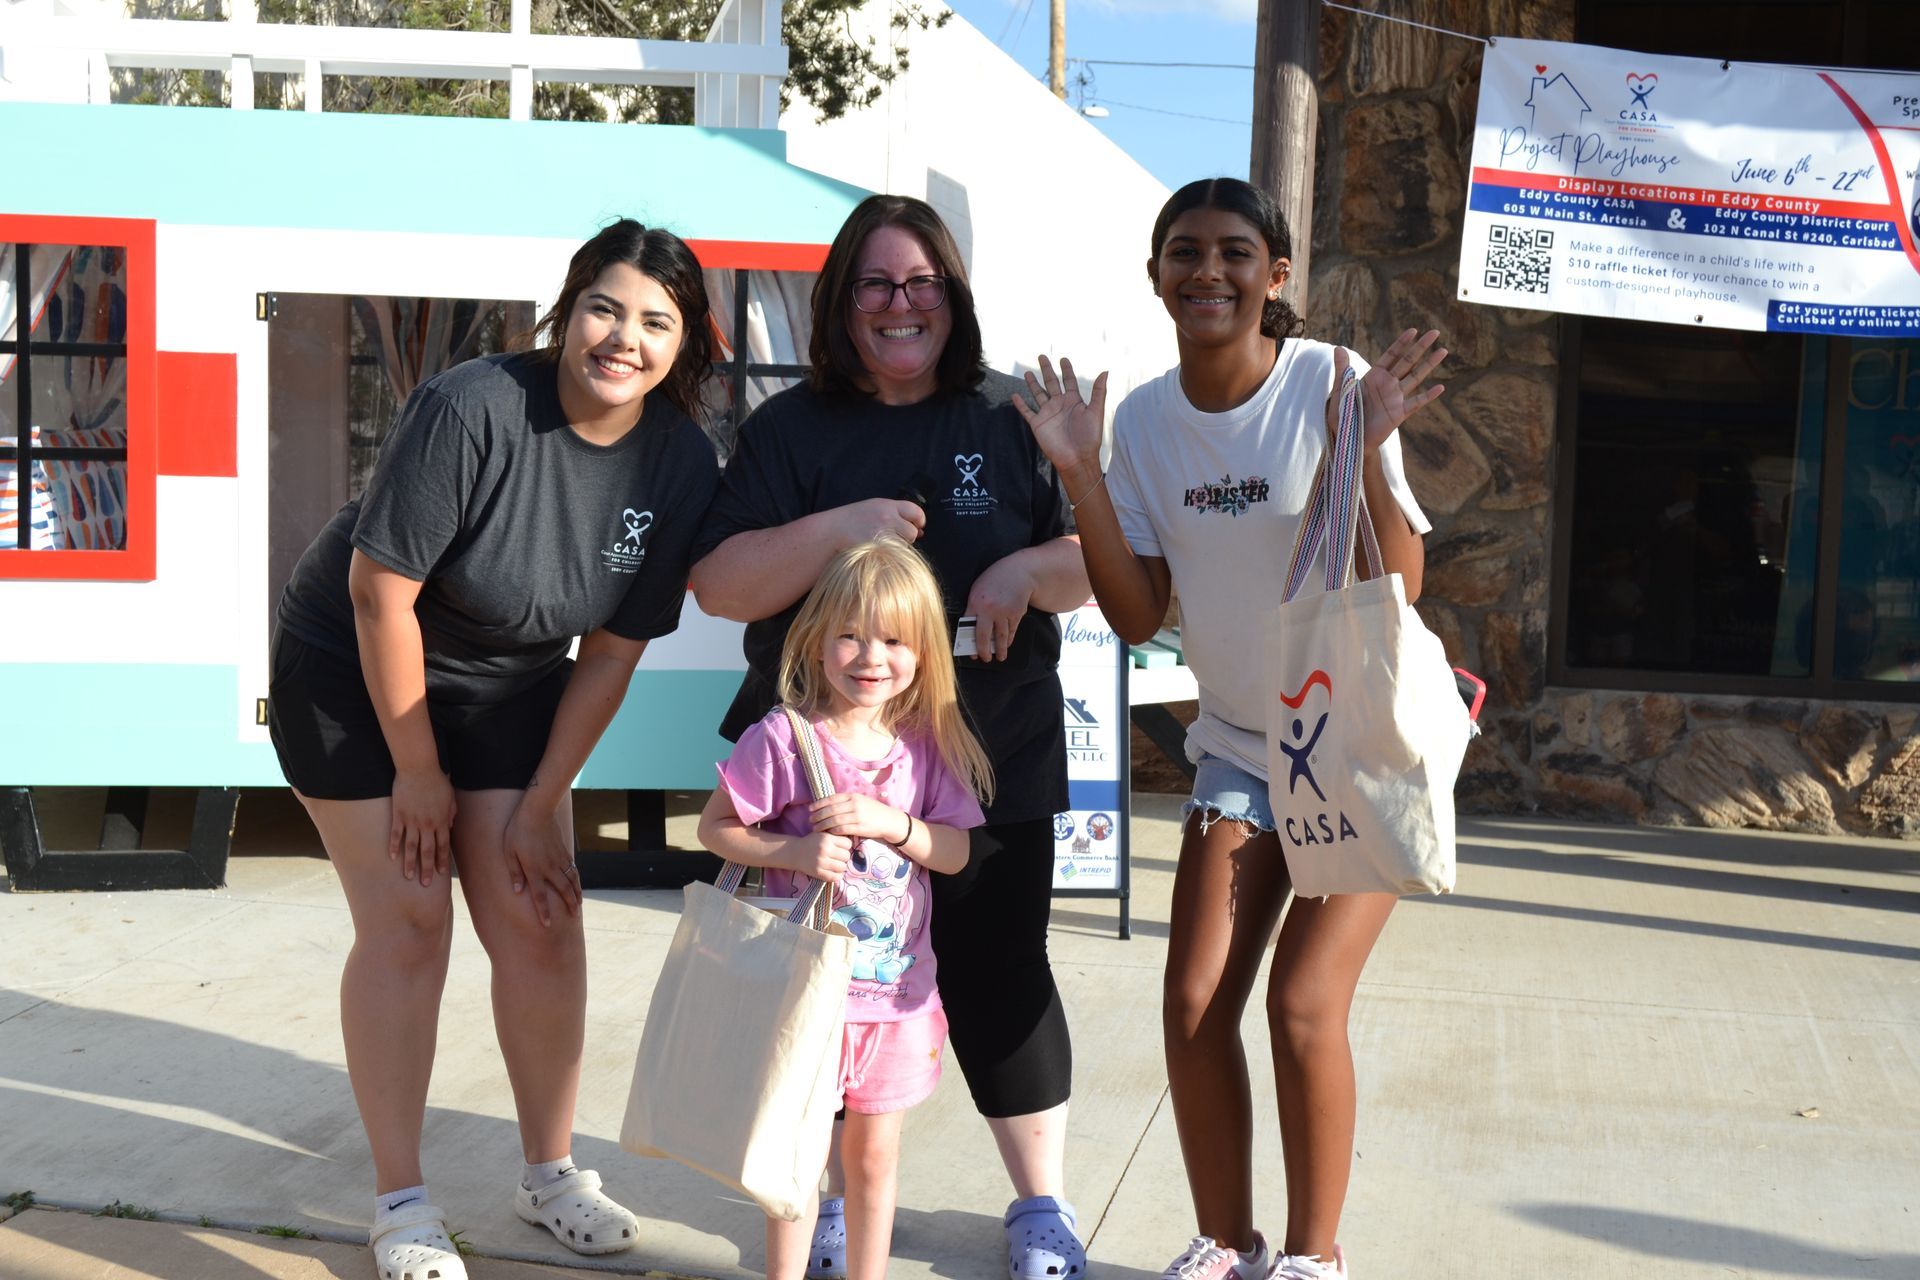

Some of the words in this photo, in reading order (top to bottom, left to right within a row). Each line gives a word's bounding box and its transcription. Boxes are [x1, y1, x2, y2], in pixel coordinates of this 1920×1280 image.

[1619, 110, 1657, 122] CASA
[1499, 126, 1574, 170] Project
[1574, 133, 1681, 177] Playhouse
[1731, 158, 1777, 184] June
[1784, 154, 1812, 186] 6th
[1519, 188, 1550, 203] Eddy
[1554, 193, 1600, 208] County
[1603, 198, 1635, 210] CASA
[1558, 178, 1615, 195] Display
[1620, 184, 1696, 202] Locations
[1701, 190, 1716, 203] in
[1722, 193, 1760, 209] Eddy
[1765, 197, 1820, 214] County
[1503, 203, 1526, 213] 605
[1530, 205, 1541, 216] W
[1544, 207, 1574, 220] Main
[1578, 211, 1596, 222] St.
[1600, 213, 1647, 227] Artesia
[1666, 208, 1687, 230] &
[1715, 208, 1747, 222] Eddy
[1751, 211, 1798, 226] County
[1801, 215, 1851, 229] District
[1855, 220, 1889, 232] Court
[1703, 223, 1726, 234] 102
[1730, 225, 1739, 236] N
[1743, 227, 1780, 239] Canal
[1784, 230, 1798, 241] St
[1802, 232, 1837, 245] #240,
[1842, 235, 1896, 248] Carlsbad
[1569, 240, 1602, 253] Make
[1606, 246, 1613, 254] a
[1617, 245, 1680, 261] difference
[1683, 251, 1695, 263] in
[1699, 255, 1706, 263] a
[1710, 255, 1750, 269] child's
[1754, 258, 1774, 270] life
[1778, 261, 1804, 273] with
[1808, 265, 1815, 273] a
[1568, 257, 1590, 269] $10
[1594, 261, 1628, 273] raffle
[1632, 264, 1667, 277] ticket
[1672, 267, 1689, 280] for
[1692, 271, 1720, 283] your
[1723, 274, 1768, 287] chance
[1772, 278, 1784, 289] to
[1788, 280, 1809, 291] win
[1813, 283, 1820, 292] a
[1566, 276, 1671, 294] custom-designed
[1674, 287, 1740, 303] playhouse.
[1777, 314, 1835, 326] Carlsbad
[1840, 318, 1854, 326] or
[1858, 318, 1901, 328] online
[1906, 318, 1920, 328] at
[1779, 303, 1800, 314] Get
[1804, 307, 1834, 316] your
[1839, 307, 1876, 317] raffle
[953, 487, 988, 497] CASA
[613, 542, 645, 556] CASA
[1286, 810, 1359, 847] CASA
